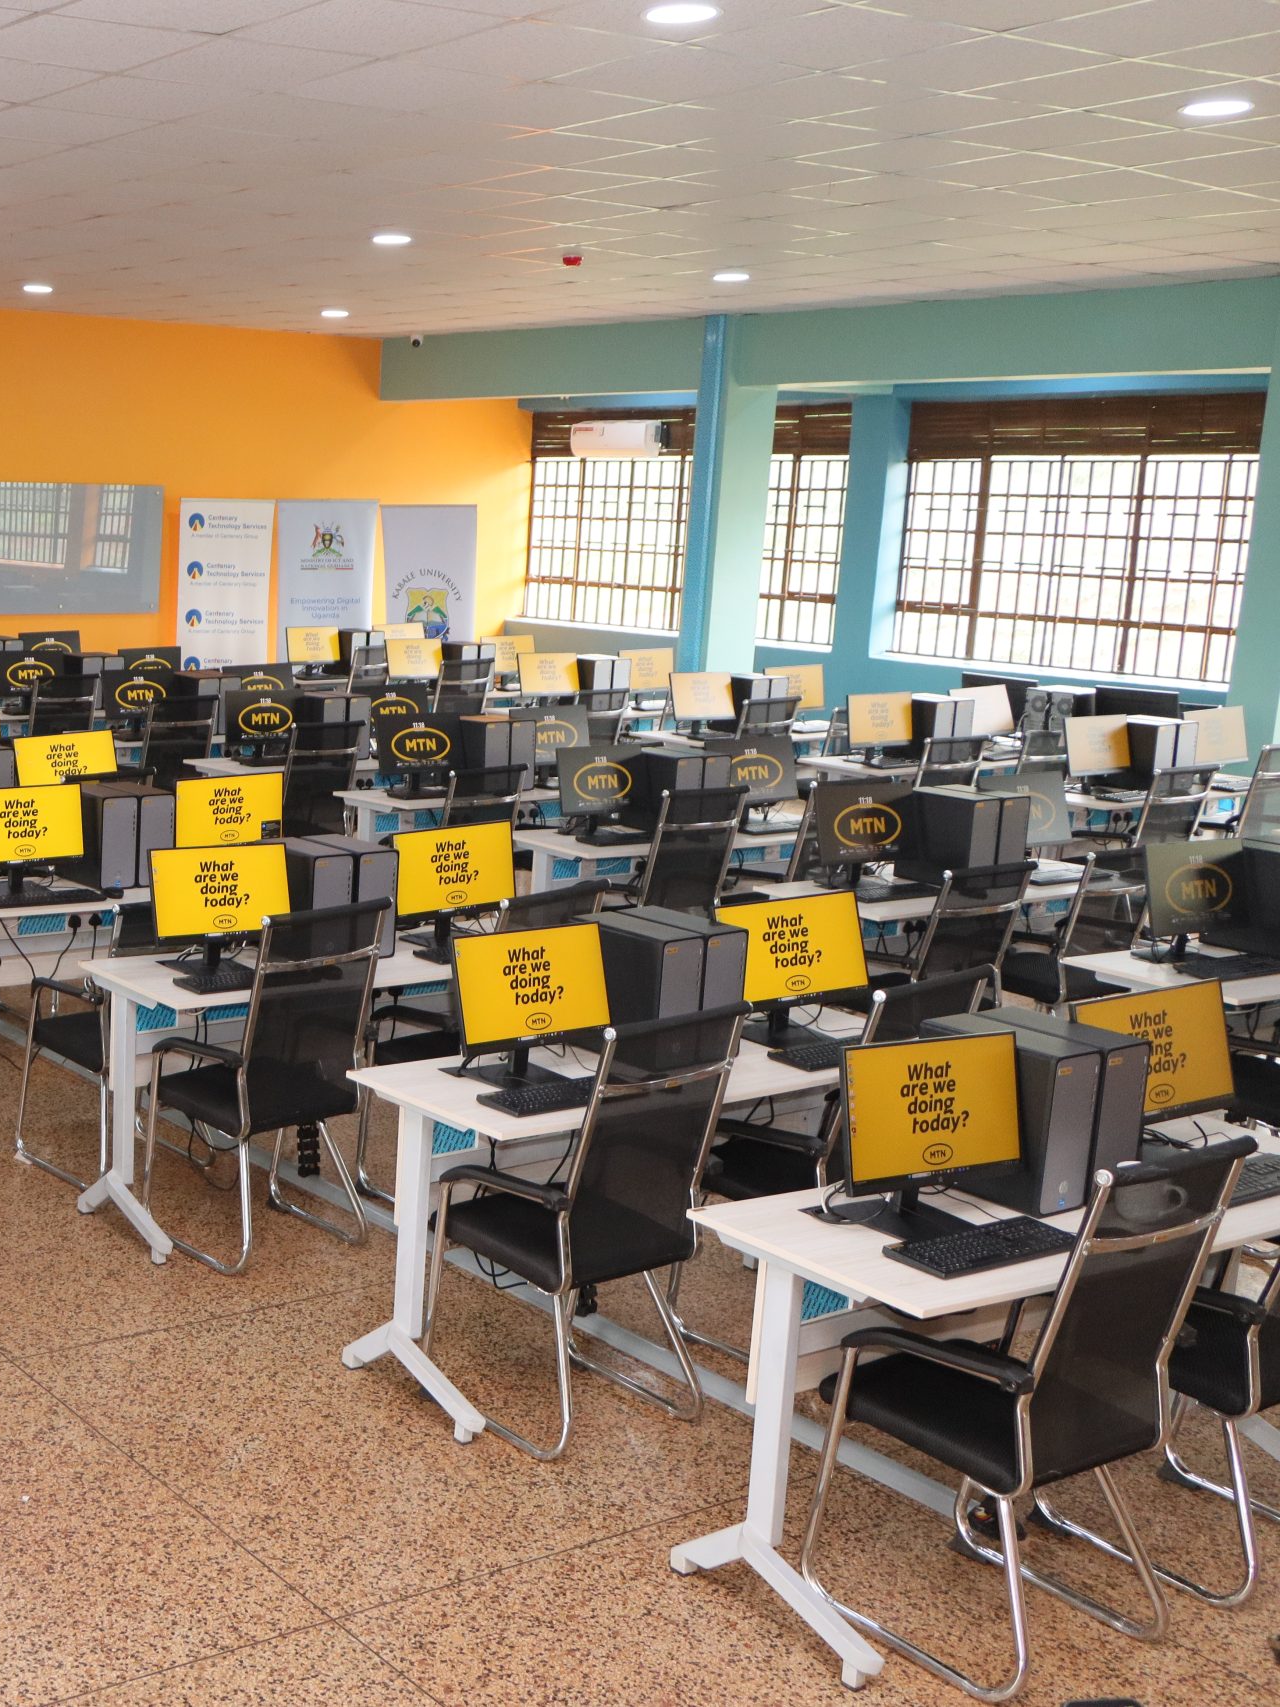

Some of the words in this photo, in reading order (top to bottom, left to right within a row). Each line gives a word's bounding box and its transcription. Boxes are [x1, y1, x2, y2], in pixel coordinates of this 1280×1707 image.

[392, 571, 416, 599] KABALE
[419, 568, 463, 601] UNIVERSITY
[336, 597, 361, 605] Digital
[204, 657, 233, 665] Centenary
[127, 689, 154, 701] MTN
[251, 713, 280, 725] MTN
[405, 738, 436, 751] MTN
[737, 765, 769, 780] MTN
[587, 774, 618, 788] MTN
[4, 799, 35, 810] What
[858, 796, 873, 805] 11:18
[0, 810, 19, 819] are
[22, 808, 39, 817] we
[4, 817, 38, 829] doing
[850, 817, 886, 835] MTN
[7, 826, 48, 839] today?
[199, 860, 235, 873] What
[194, 873, 217, 884] are
[220, 872, 239, 882] we
[200, 881, 239, 896] doing
[1181, 879, 1216, 897] MTN
[204, 893, 250, 909] today?
[766, 913, 804, 930] What
[762, 929, 786, 942] are
[789, 926, 809, 939] we
[769, 938, 809, 955] doing
[507, 946, 546, 963] What
[775, 949, 822, 969] today?
[502, 963, 527, 977] are
[530, 960, 551, 973] we
[509, 972, 551, 990] doing
[515, 985, 564, 1005] today?
[1129, 1009, 1168, 1030] What
[1153, 1025, 1173, 1039] we
[907, 1061, 952, 1082] What
[1147, 1052, 1187, 1076] oday?
[900, 1081, 929, 1098] are
[933, 1079, 956, 1094] we
[1154, 1089, 1169, 1098] MTN
[907, 1094, 955, 1115] doing
[912, 1110, 970, 1134] today?
[929, 1149, 946, 1158] MTN
